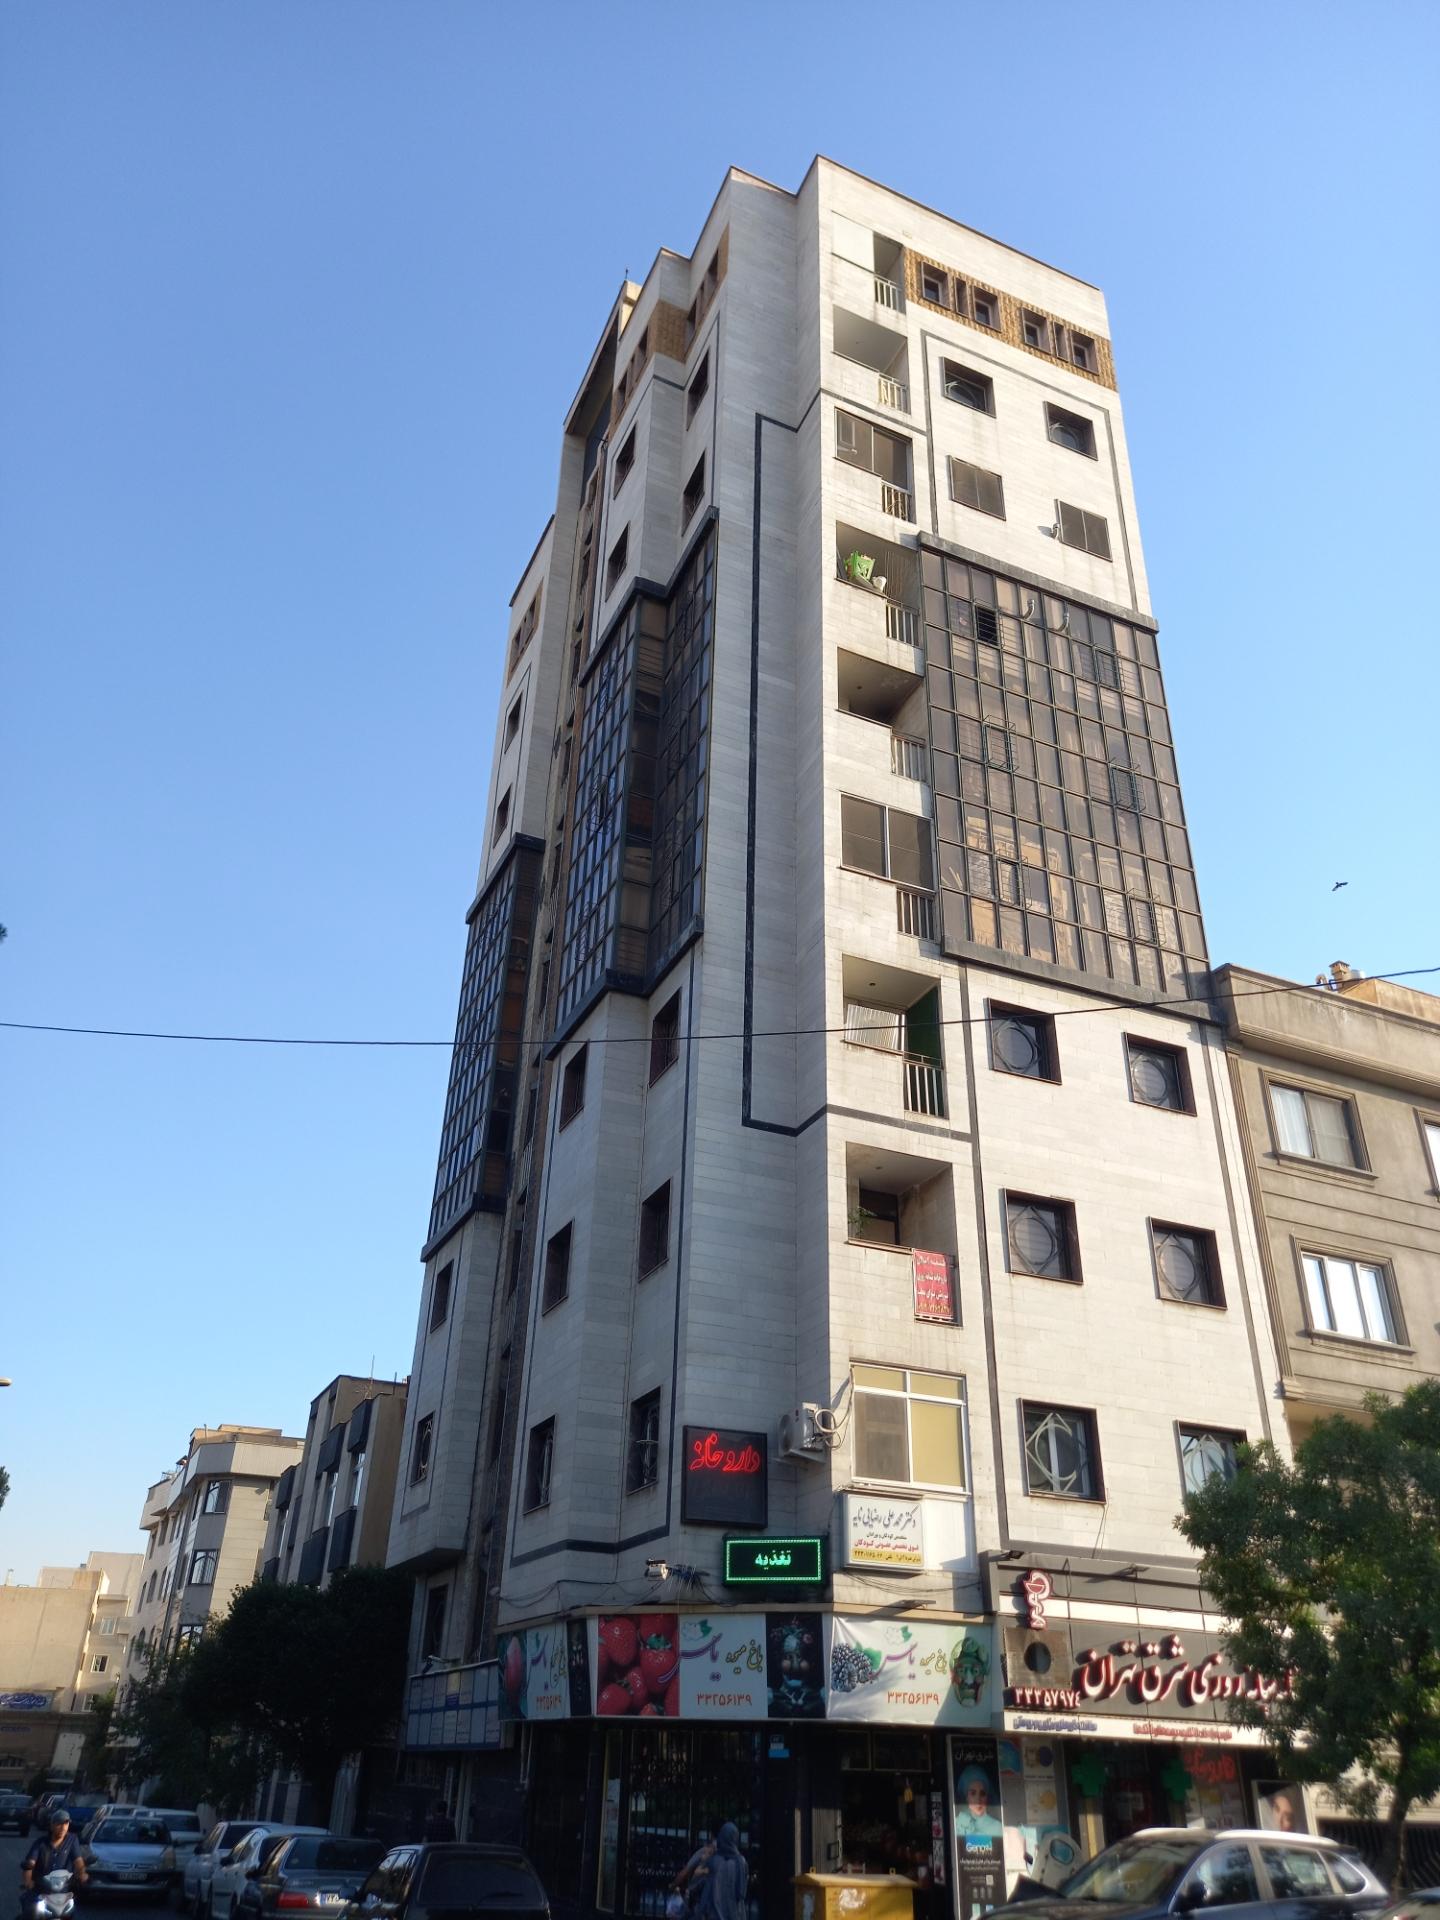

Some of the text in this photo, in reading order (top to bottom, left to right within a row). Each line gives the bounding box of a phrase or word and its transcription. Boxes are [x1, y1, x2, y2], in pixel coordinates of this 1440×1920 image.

[901, 1505, 919, 1530] دکتر
[755, 1550, 792, 1570] تغذیه
[726, 1644, 747, 1674] میوه
[746, 1639, 763, 1672] باغ
[934, 1648, 948, 1675] باغ
[1082, 1640, 1138, 1698] تهران
[1139, 1634, 1189, 1703] شرق
